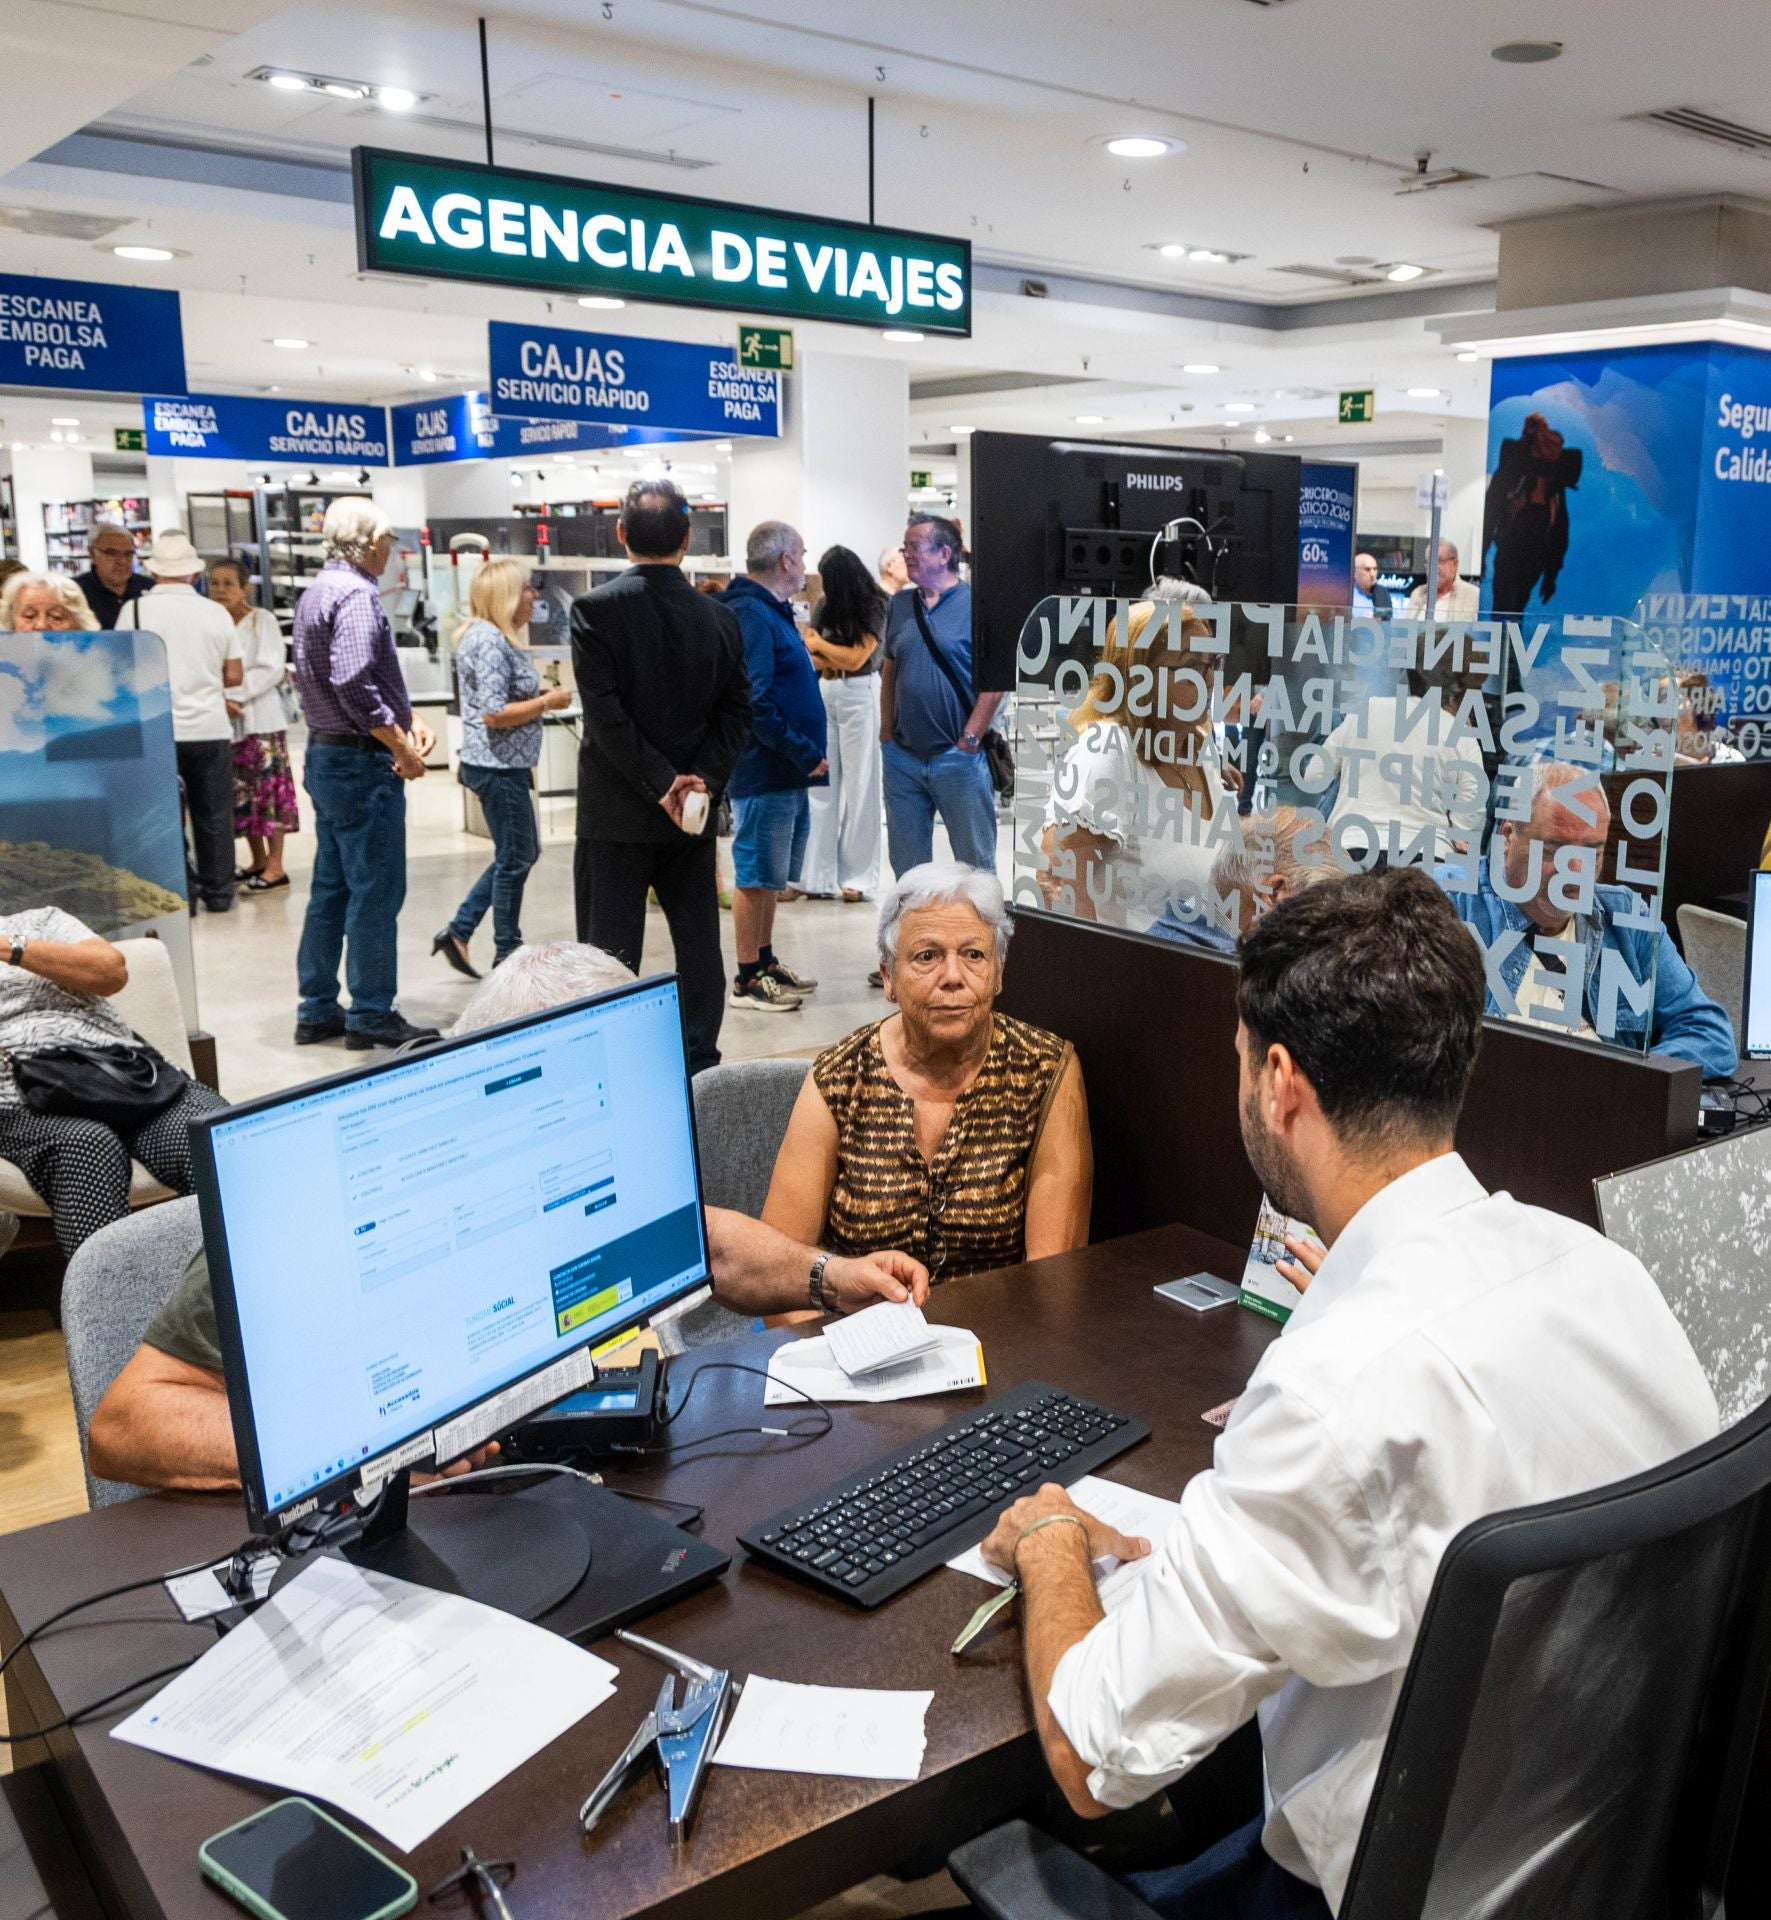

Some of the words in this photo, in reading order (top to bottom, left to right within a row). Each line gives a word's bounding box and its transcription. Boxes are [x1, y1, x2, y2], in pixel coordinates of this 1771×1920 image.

[379, 185, 694, 277] AGENCIA
[711, 230, 788, 289] DE
[792, 241, 965, 314] VIAJES
[0, 295, 103, 323] ESCANEA
[0, 319, 107, 348] EMBOLSA
[25, 346, 85, 370] PAGA
[520, 340, 626, 386] CAJAS
[709, 361, 774, 384] ESCANEA
[497, 378, 580, 407] SERVICIO
[585, 382, 649, 412] RÁPIDO
[708, 380, 776, 403] EMBOLSA
[154, 402, 216, 419] ESCANEA
[724, 400, 761, 421] PAGA
[154, 416, 218, 434] EMBOLSA
[286, 411, 366, 440] CAJAS
[416, 409, 448, 438] CAJAS
[170, 432, 206, 447] PAGA
[269, 436, 333, 454] SERVICIO
[335, 437, 385, 457] RÁPIDO
[1127, 473, 1183, 491] PHILIPS
[1330, 503, 1351, 522] 2026
[1302, 544, 1328, 562] 60%
